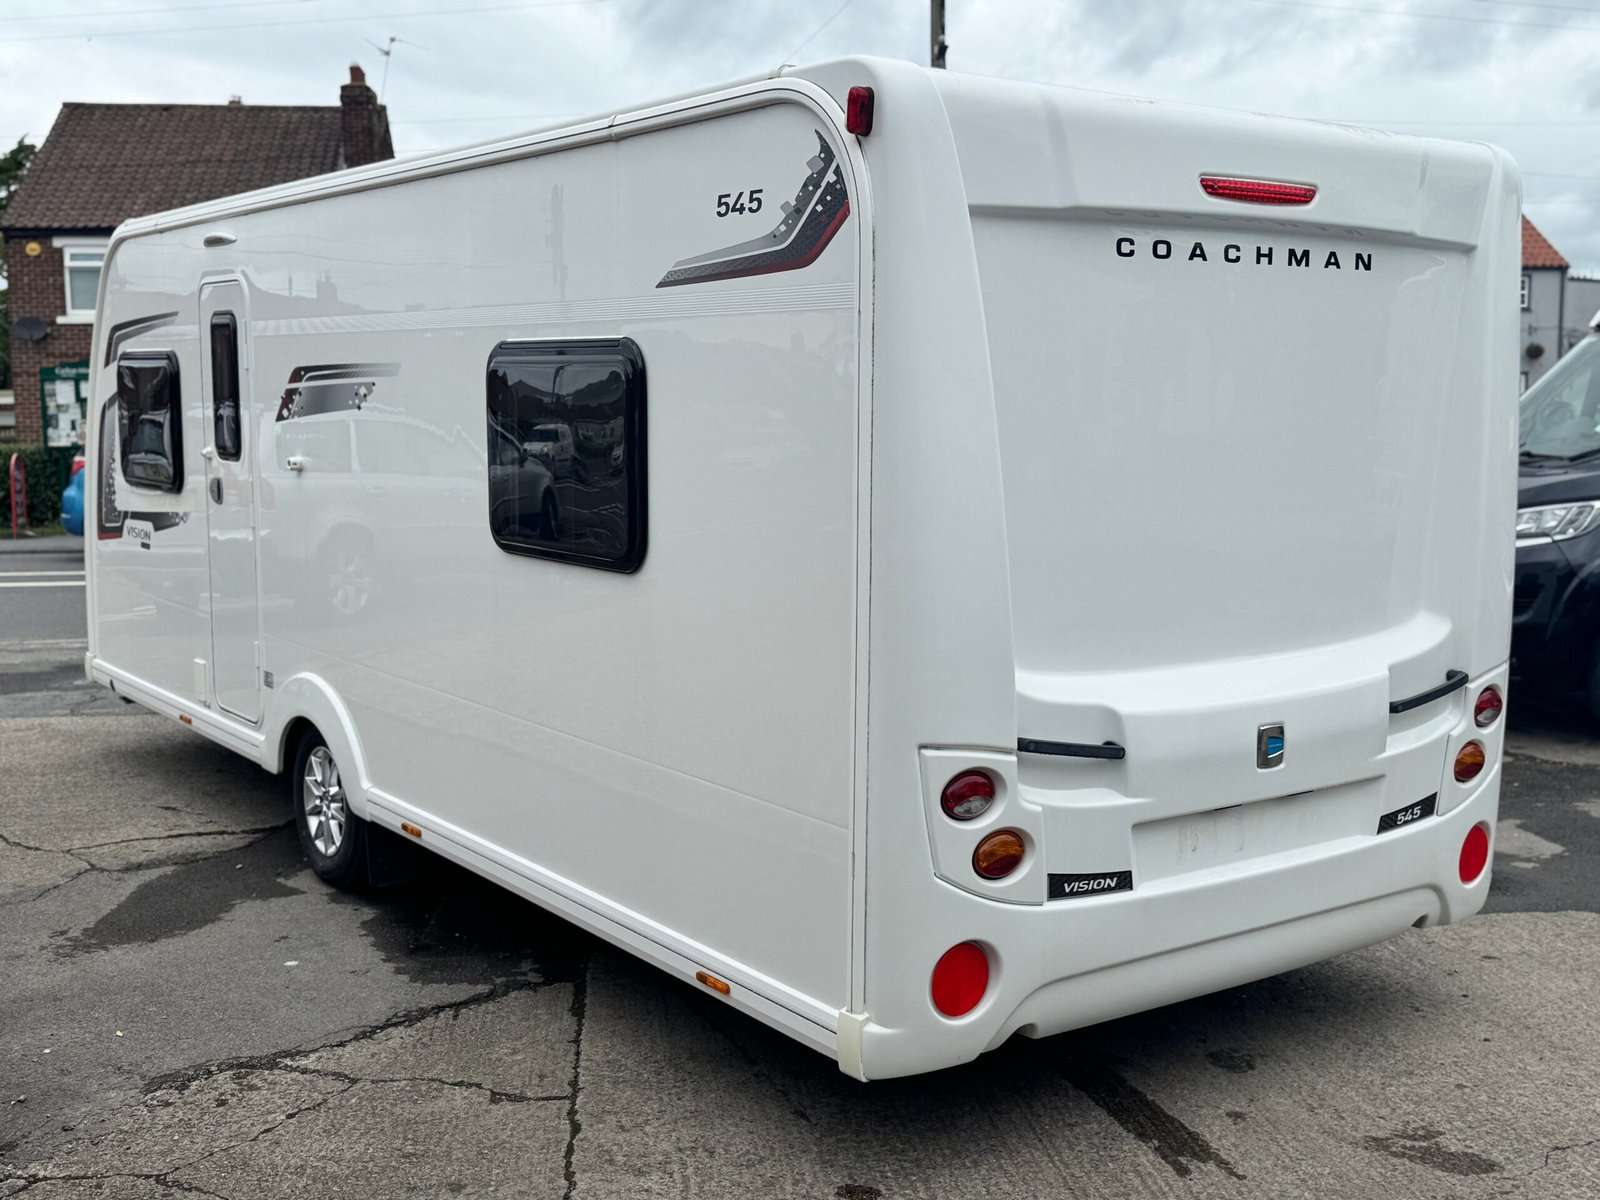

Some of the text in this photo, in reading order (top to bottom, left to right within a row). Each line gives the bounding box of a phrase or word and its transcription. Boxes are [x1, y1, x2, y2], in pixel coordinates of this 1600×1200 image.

[715, 189, 764, 218] 545
[1115, 236, 1373, 272] COACHMAN
[126, 525, 152, 542] VISION
[1396, 805, 1422, 825] 545
[1063, 877, 1118, 893] VISION
